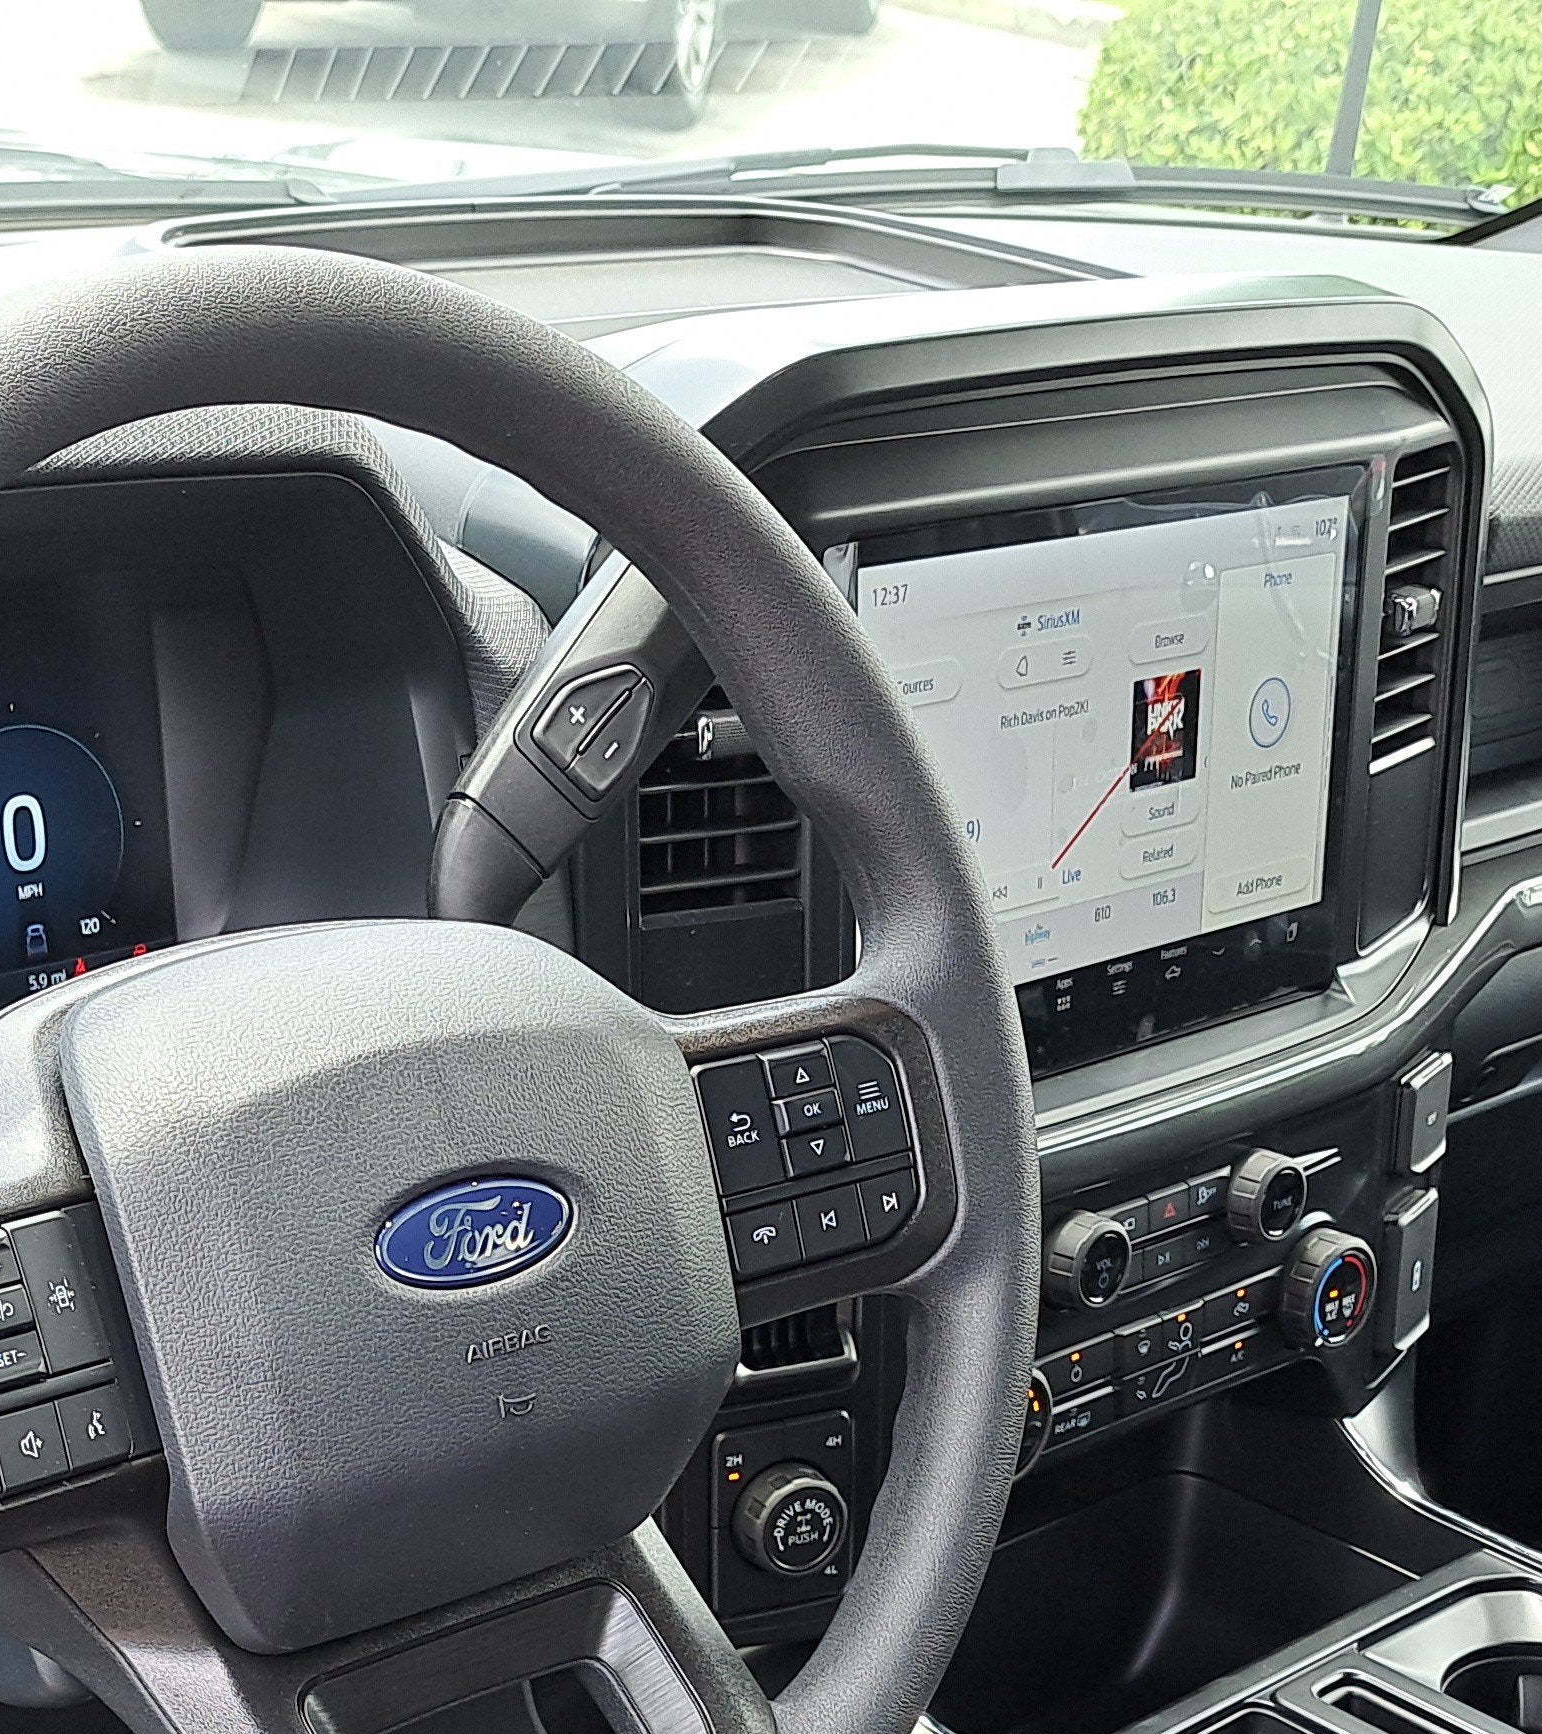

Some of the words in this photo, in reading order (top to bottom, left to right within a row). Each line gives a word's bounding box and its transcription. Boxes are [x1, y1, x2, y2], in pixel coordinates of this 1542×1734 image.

[1263, 571, 1293, 589] Phone
[872, 583, 909, 607] 12:37
[1037, 608, 1081, 632] SiriusXM
[1155, 632, 1185, 650] Browse
[898, 677, 935, 697] ources
[1000, 712, 1020, 731] Rich
[1020, 709, 1044, 727] Davis
[1045, 707, 1057, 721] on
[1230, 774, 1244, 790] No
[1245, 767, 1273, 787] Paired
[1274, 763, 1302, 782] Phone
[1148, 801, 1175, 820] Sound
[2, 794, 46, 872] 0
[1142, 843, 1175, 863] Related
[1061, 868, 1082, 885] Live
[1236, 879, 1254, 897] Add
[1254, 874, 1284, 892] Phone
[17, 881, 44, 900] MPH
[79, 917, 100, 935] 120
[28, 972, 48, 991] 5.9
[50, 968, 67, 985] mi
[803, 1102, 822, 1117] OK
[856, 1097, 889, 1116] MENU
[727, 1131, 760, 1149] BACK
[423, 1194, 535, 1271] Ford
[465, 1323, 553, 1365] AIRBAG
[825, 1434, 842, 1447] 4H
[725, 1453, 743, 1468] 2H
[772, 1500, 805, 1538] DRIVE
[804, 1498, 834, 1527] MODE
[788, 1530, 819, 1547] PUSH
[824, 1565, 839, 1576] 4L
